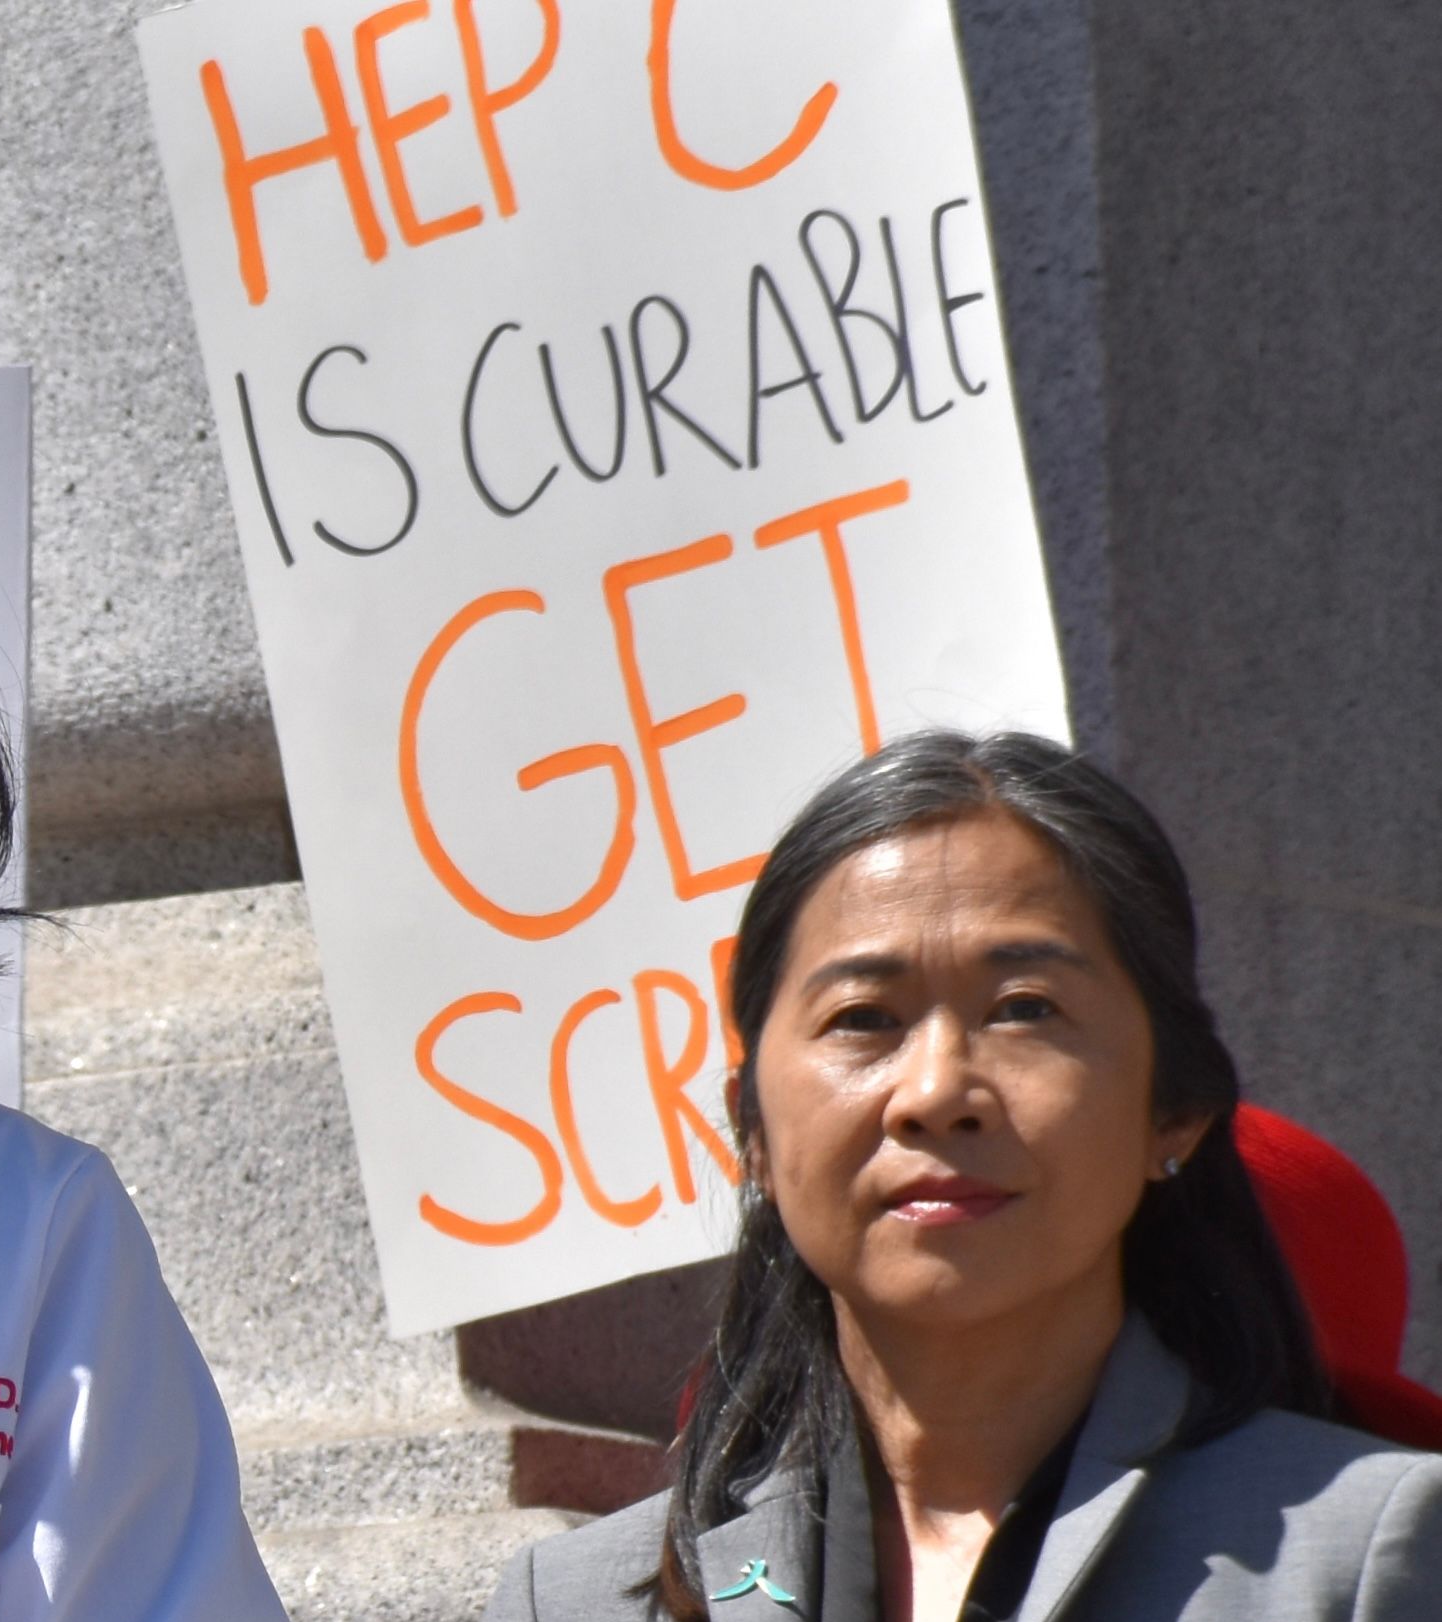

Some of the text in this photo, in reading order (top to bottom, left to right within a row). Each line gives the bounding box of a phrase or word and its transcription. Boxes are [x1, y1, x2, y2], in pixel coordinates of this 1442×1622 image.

[200, 0, 561, 306] HEP
[235, 197, 988, 566] IS CURABLE
[398, 478, 910, 940] GET
[414, 934, 745, 1247] SCR
